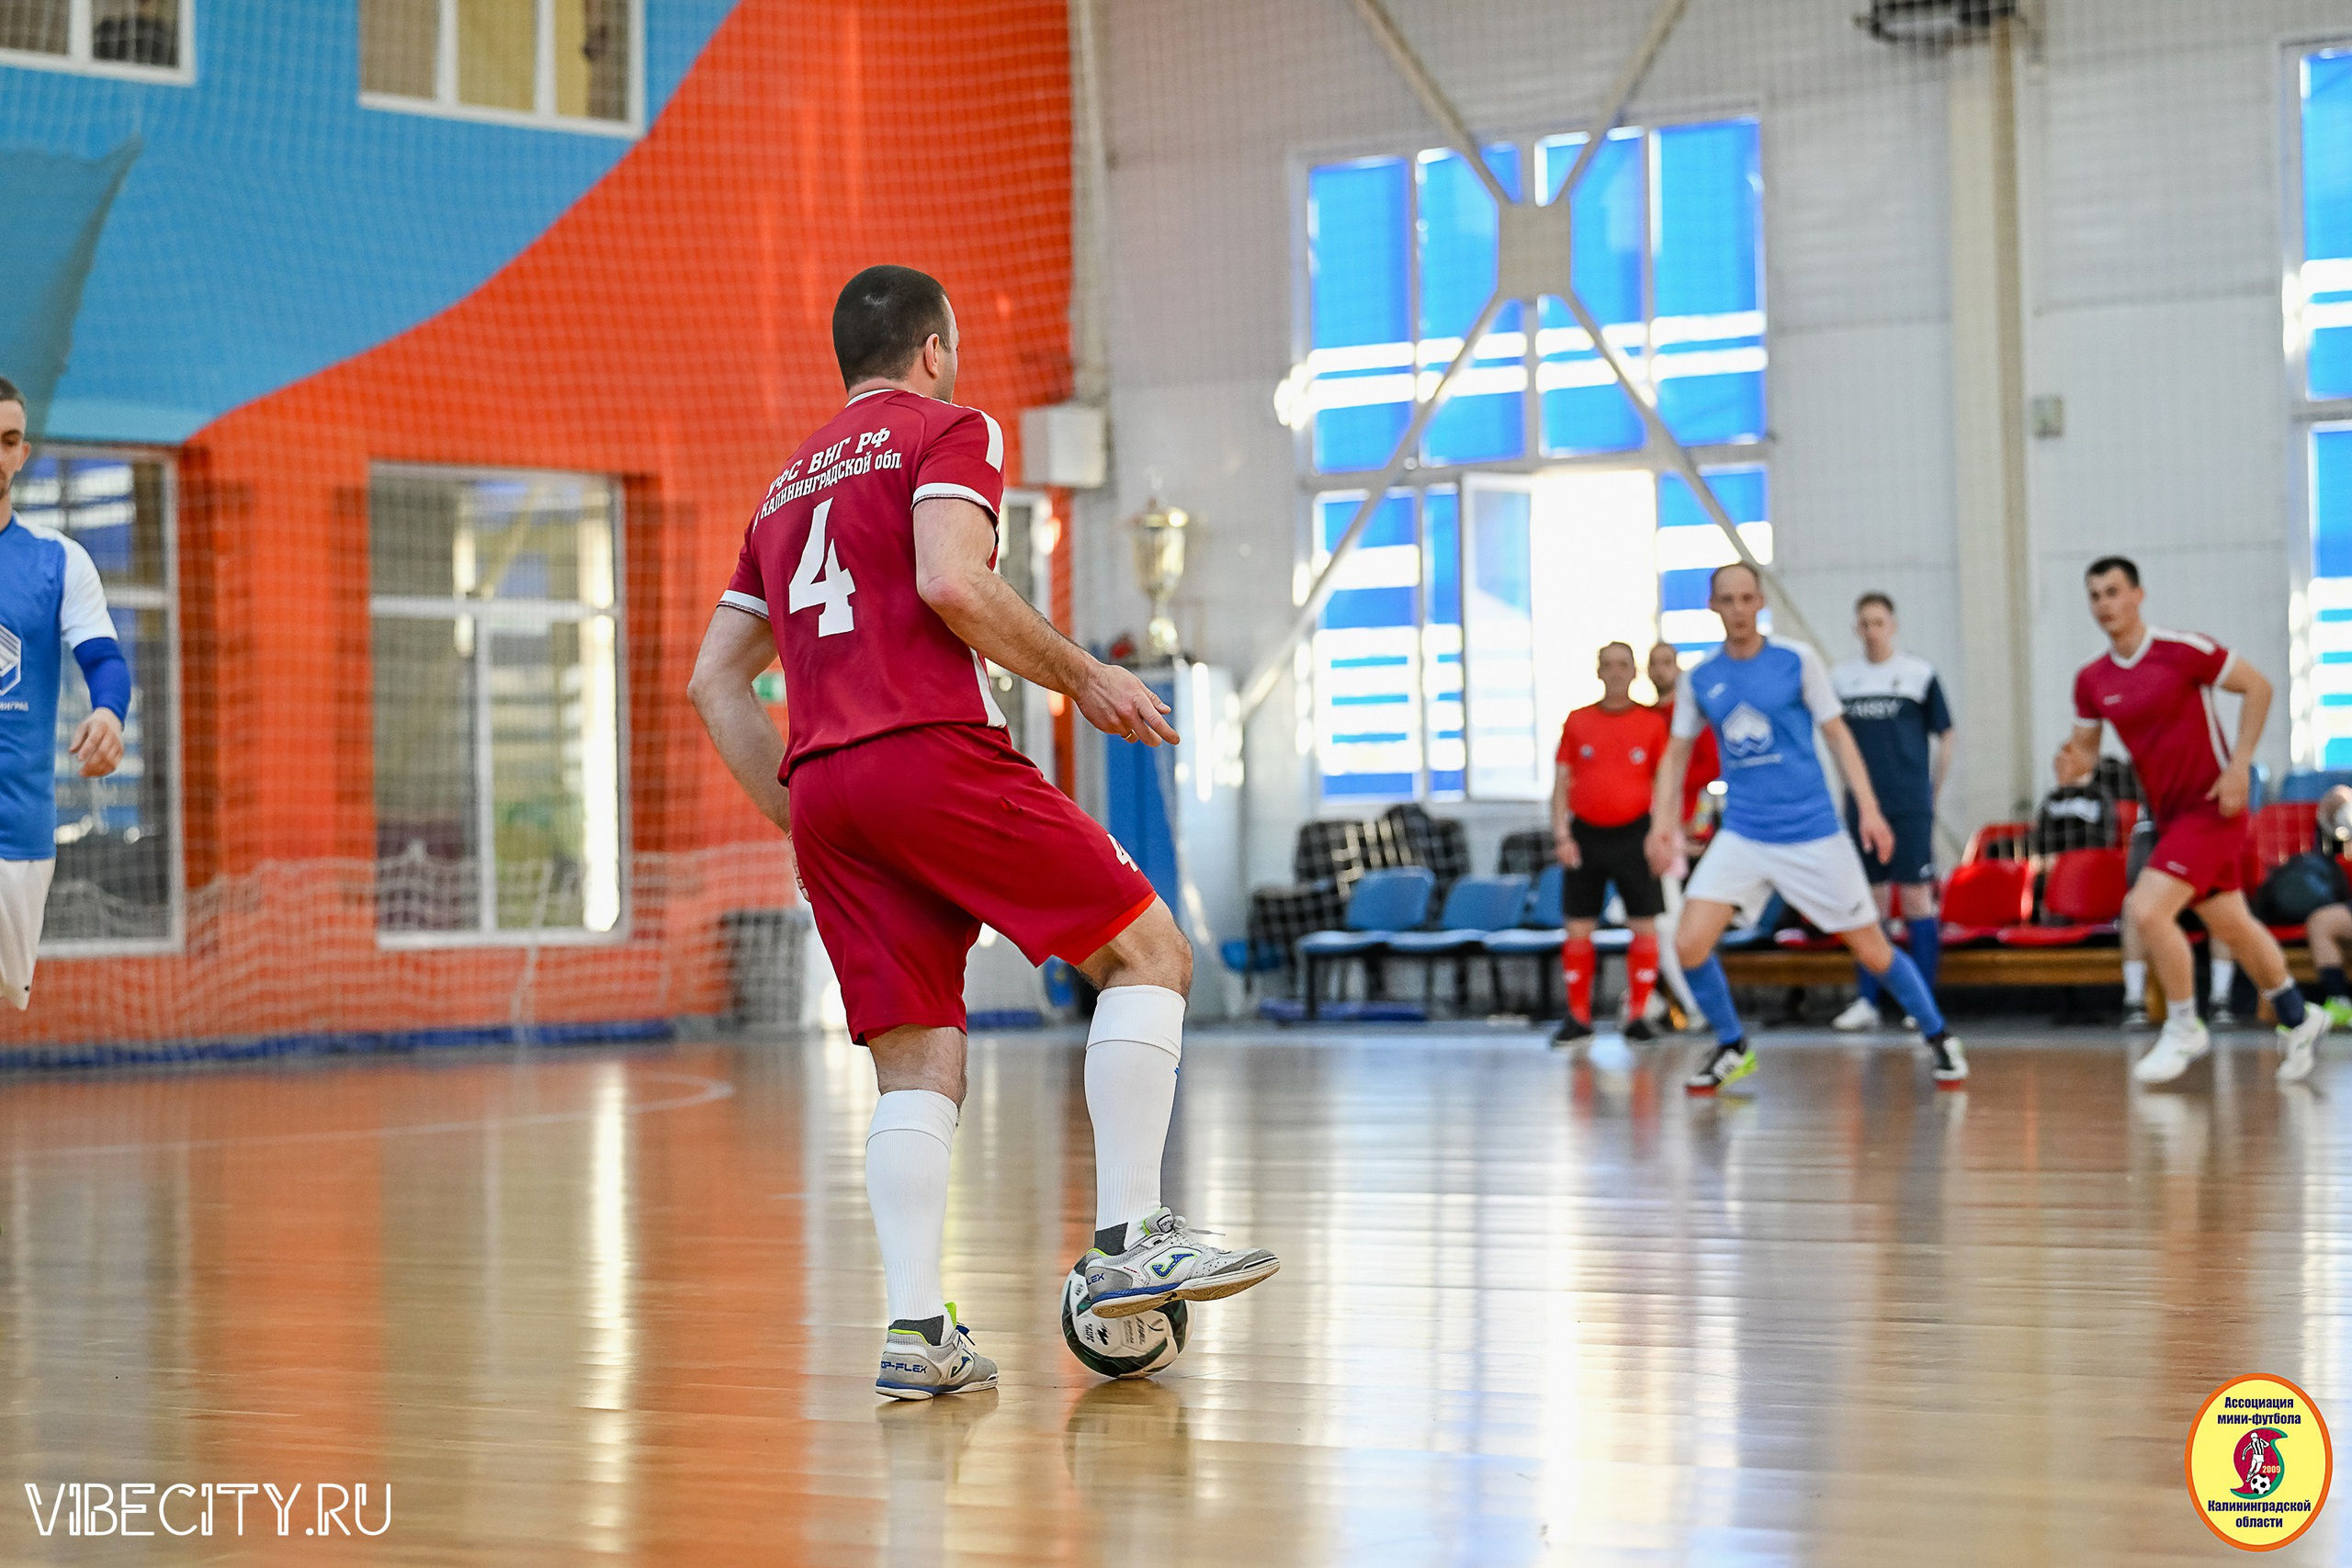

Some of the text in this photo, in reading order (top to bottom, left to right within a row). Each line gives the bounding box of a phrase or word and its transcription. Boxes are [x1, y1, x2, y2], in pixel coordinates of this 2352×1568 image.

[760, 450, 873, 520] КАЛИНИНГРАДСКОЙ
[765, 427, 891, 500] УФС ВНГ РФ
[788, 496, 856, 638] 4
[1106, 833, 1139, 873] 4
